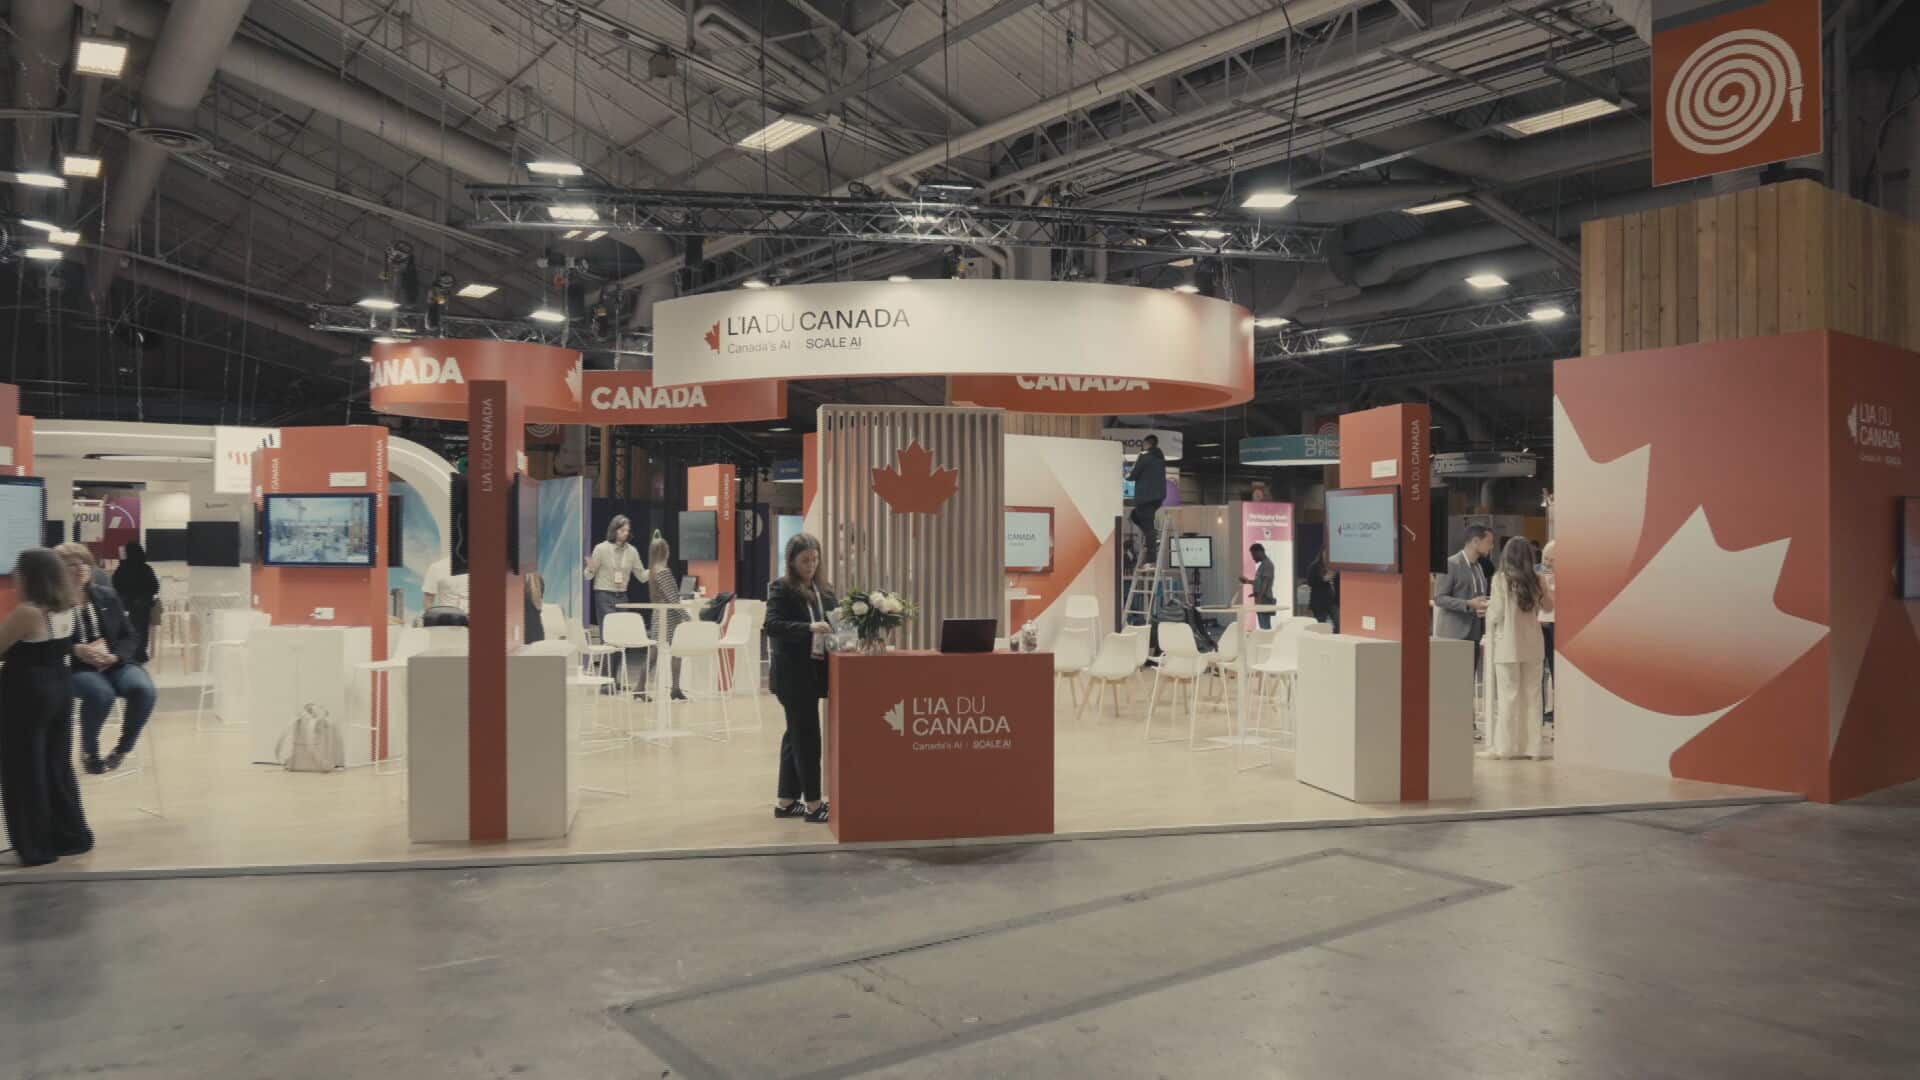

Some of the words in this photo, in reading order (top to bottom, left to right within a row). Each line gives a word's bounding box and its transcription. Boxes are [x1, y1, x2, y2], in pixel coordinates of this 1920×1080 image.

[728, 315, 761, 336] L'IA
[765, 313, 795, 333] DU
[799, 308, 910, 332] CANADA
[728, 341, 777, 354] Canada's
[806, 337, 846, 350] SCALE
[850, 337, 862, 349] AI
[371, 356, 464, 388] ANADA
[591, 385, 707, 410] CANADA
[482, 398, 493, 451] CANADA
[1860, 425, 1901, 448] CANADA
[1411, 419, 1420, 465] CANADA
[913, 696, 950, 715] L'IA
[957, 695, 986, 714] DU
[912, 715, 1011, 736] CANADA
